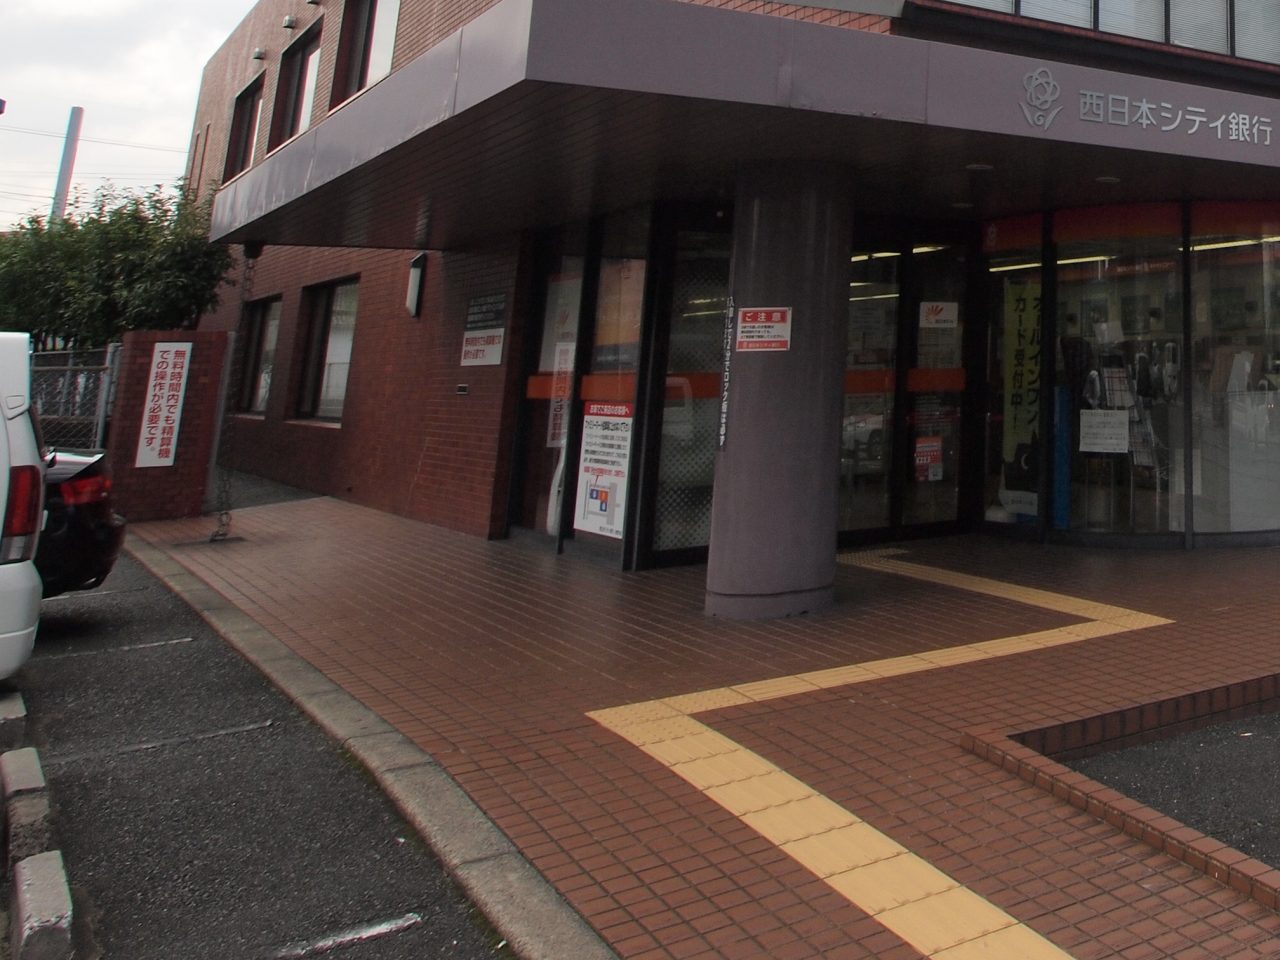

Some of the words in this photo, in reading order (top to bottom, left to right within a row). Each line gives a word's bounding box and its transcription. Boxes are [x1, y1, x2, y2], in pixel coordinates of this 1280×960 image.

[1079, 89, 1272, 145] 西日本シティ銀行
[745, 312, 782, 322] ご注意
[145, 350, 170, 452] での操作が必要です。
[158, 350, 186, 458] 無料時間内でも精算機
